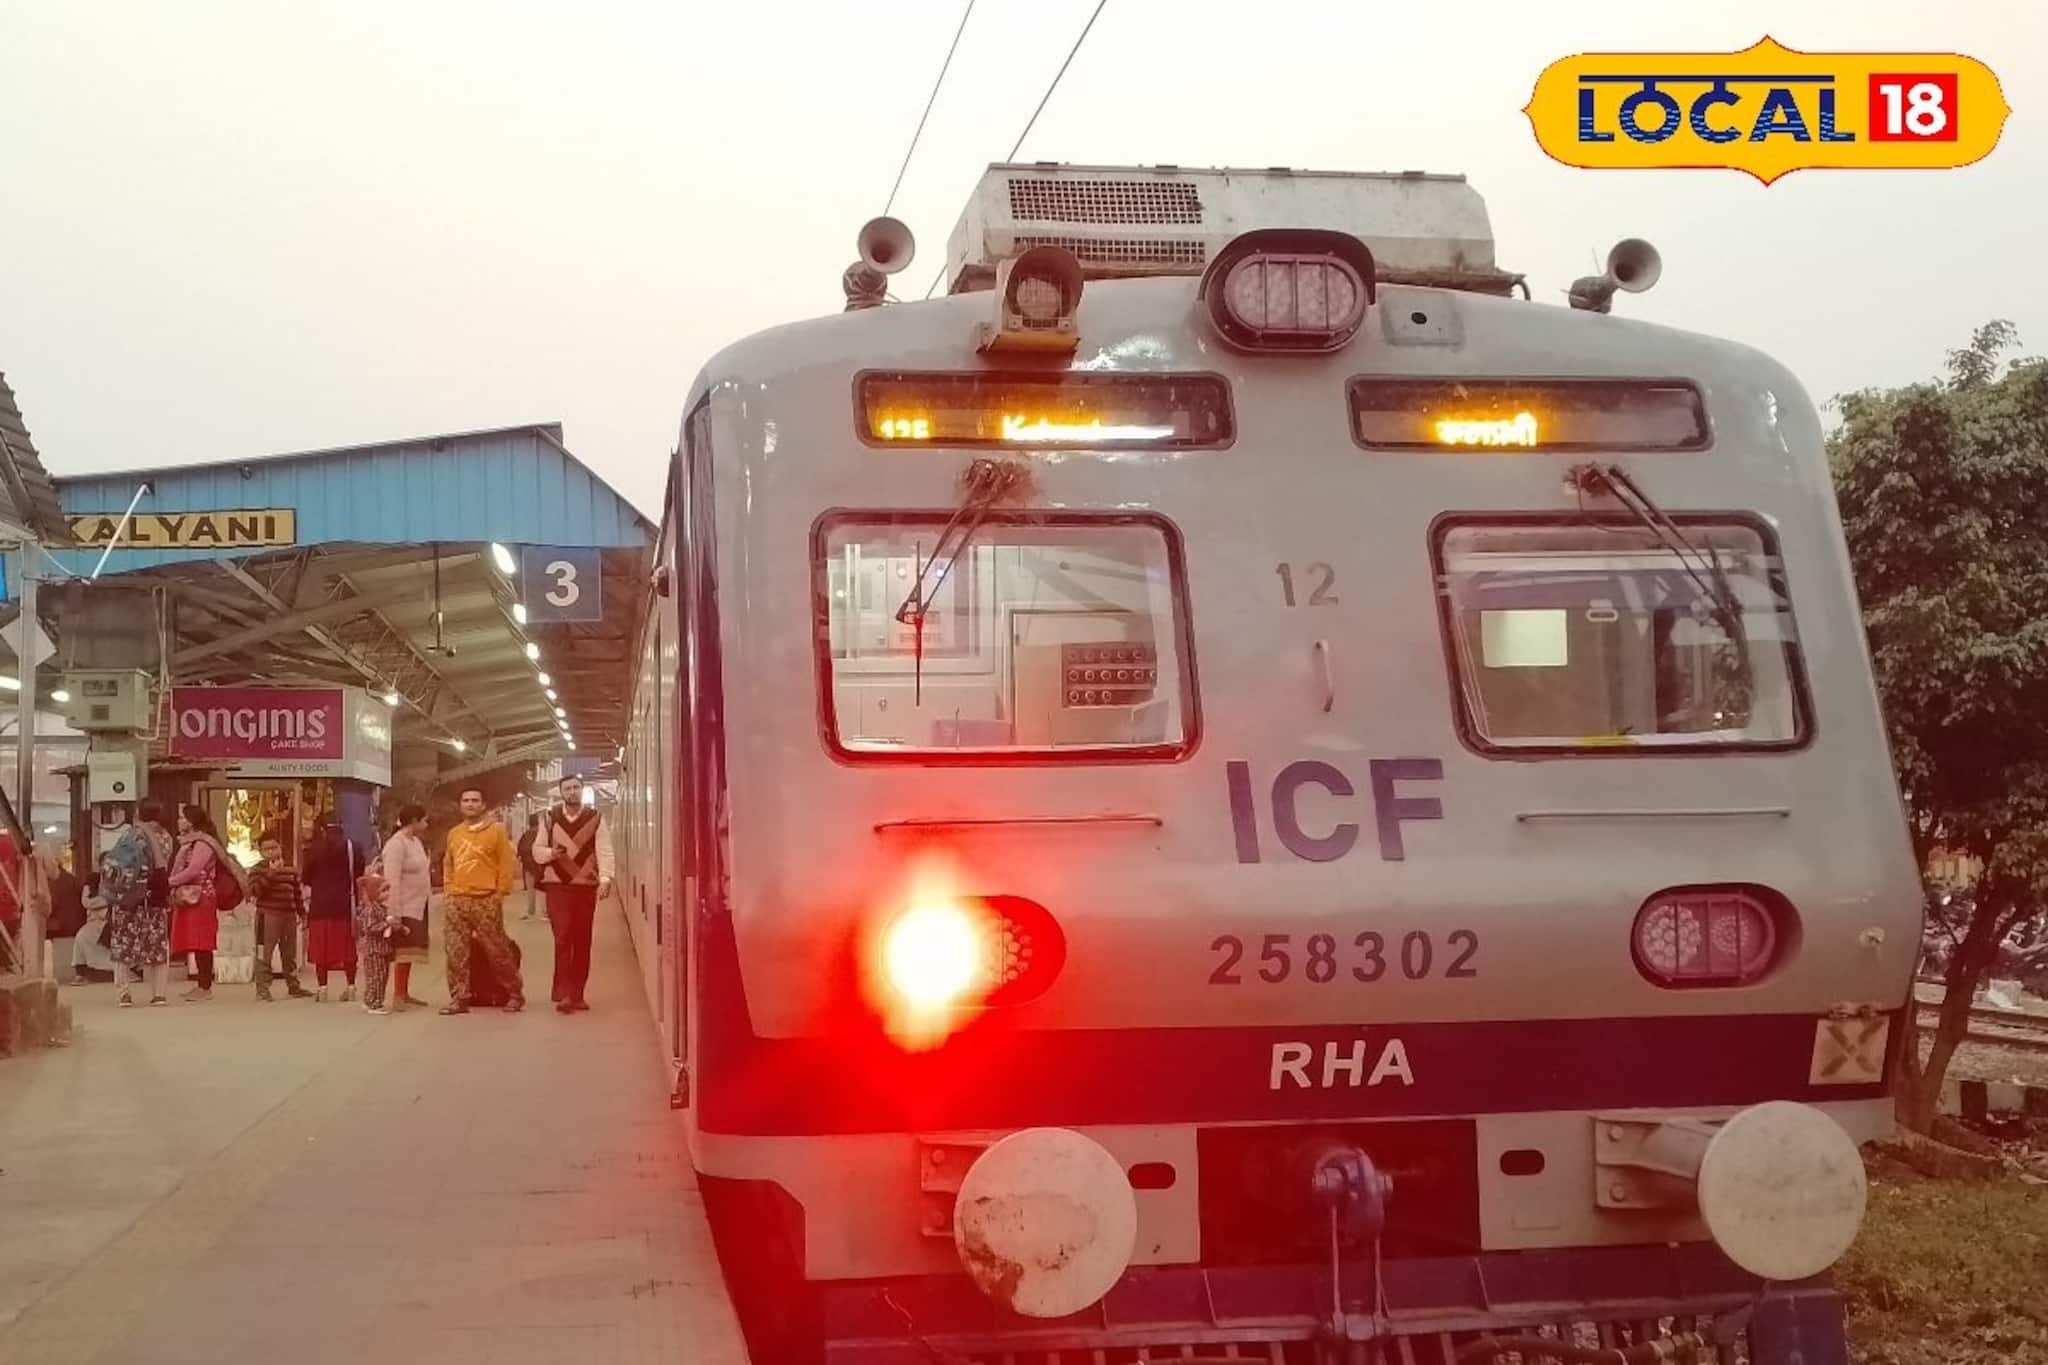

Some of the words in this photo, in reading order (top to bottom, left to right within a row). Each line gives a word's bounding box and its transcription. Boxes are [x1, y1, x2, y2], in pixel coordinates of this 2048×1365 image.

[545, 561, 580, 607] 3
[1275, 562, 1339, 607] 12
[1226, 758, 1444, 864] ICF
[1207, 929, 1480, 986] 258302
[1269, 1038, 1415, 1090] RHA
